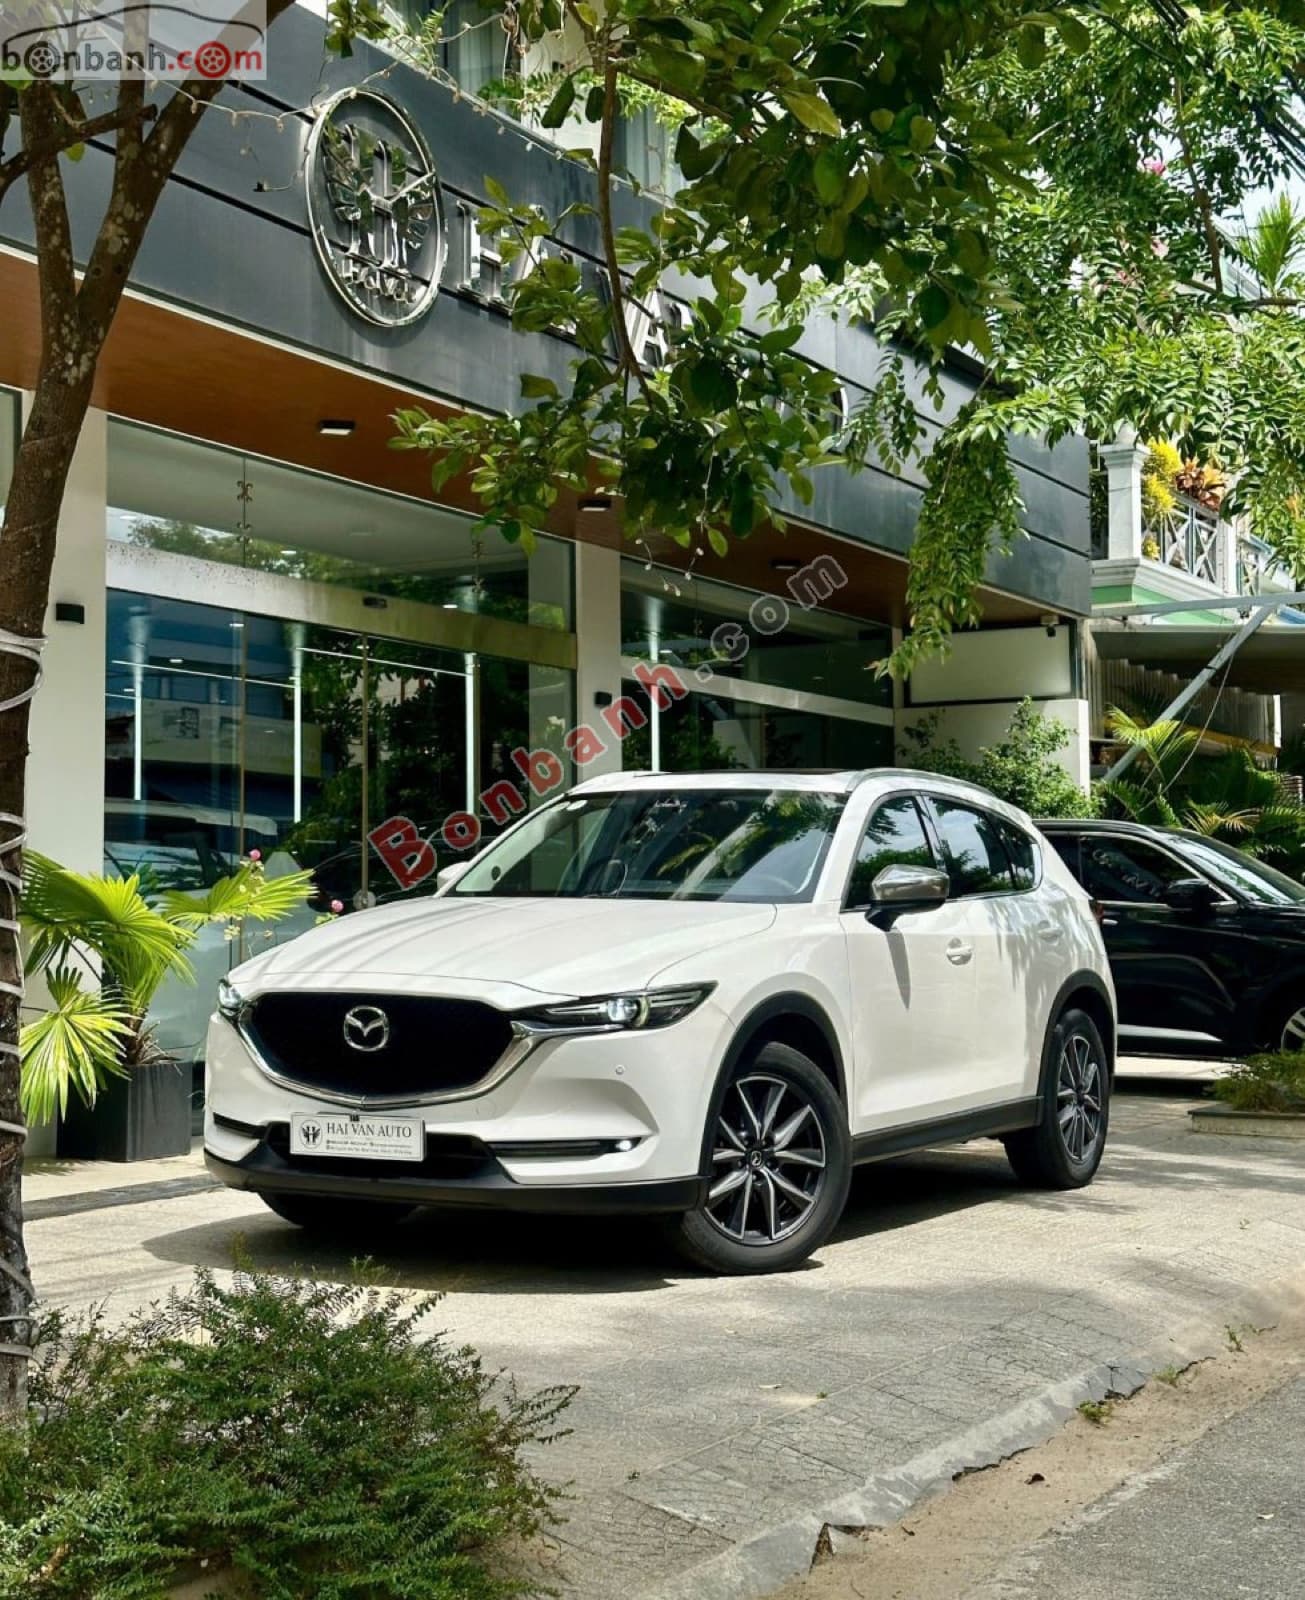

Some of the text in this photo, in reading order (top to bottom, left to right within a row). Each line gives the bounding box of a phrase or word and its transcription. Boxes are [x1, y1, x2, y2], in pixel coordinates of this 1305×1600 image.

[327, 1122, 412, 1138] HAI VAN AUTO
